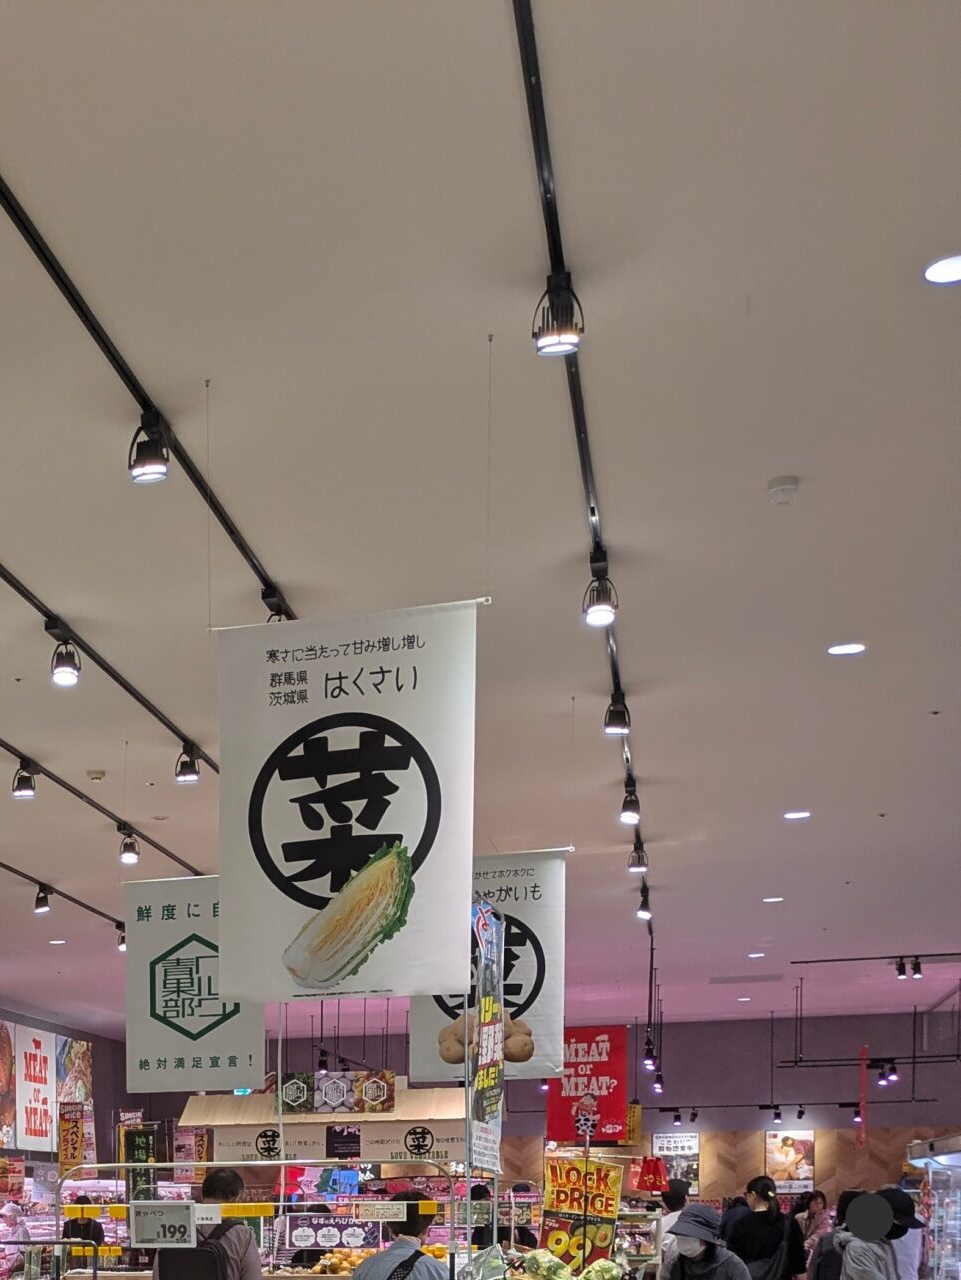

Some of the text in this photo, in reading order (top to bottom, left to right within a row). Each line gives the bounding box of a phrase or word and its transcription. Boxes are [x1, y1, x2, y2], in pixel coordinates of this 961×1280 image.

[265, 634, 426, 663] 寒さに当たって甘み増し増し
[269, 671, 308, 688] 群馬県
[325, 666, 418, 700] はくさい
[269, 689, 309, 707] 茨城県
[563, 1041, 610, 1063] MEAT
[138, 1054, 254, 1071] 絶対満足宣言！
[578, 1063, 593, 1075] or
[561, 1076, 618, 1097] MEAT?
[160, 1223, 188, 1239] 199
